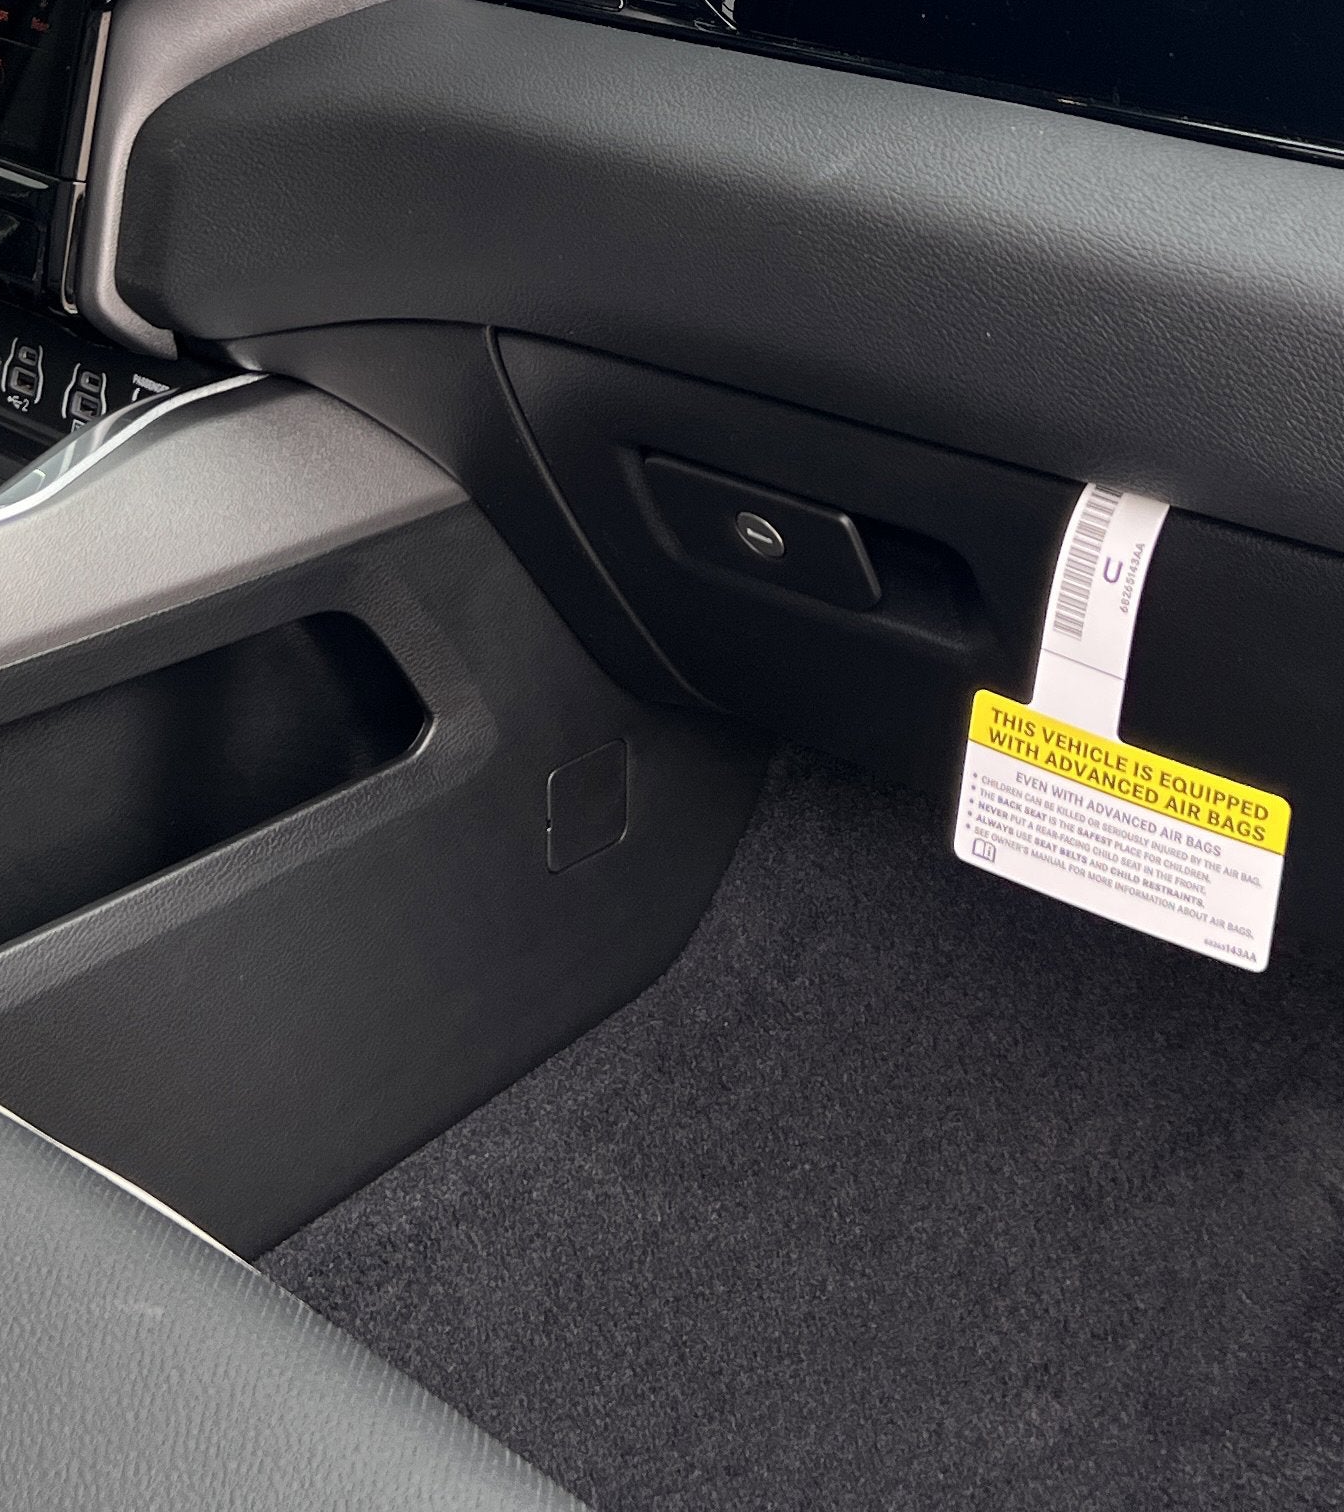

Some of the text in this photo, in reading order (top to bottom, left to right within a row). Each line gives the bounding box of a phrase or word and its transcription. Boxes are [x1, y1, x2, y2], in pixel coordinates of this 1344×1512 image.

[988, 727, 1266, 842] WITH ADVANCED AIR BAGS
[991, 707, 1269, 821] THIS VEHICLE IS EQUIPPED
[976, 814, 1014, 835] ALWAYS
[1016, 829, 1033, 842] USE
[1034, 837, 1056, 853] SEAT
[1059, 849, 1087, 864] BELTS
[1089, 859, 1108, 872] AND
[1110, 866, 1140, 884] CHILD
[978, 801, 1009, 820] NEVER
[1010, 813, 1026, 826] PUT
[1092, 846, 1119, 863] CHILD
[1120, 856, 1142, 872] SEAT
[1144, 865, 1153, 875] IN
[1156, 869, 1173, 882] THE
[980, 788, 995, 801] THE
[997, 796, 1022, 812] BACK
[1025, 806, 1047, 821] SEAT
[1048, 814, 1056, 824] IS
[1058, 818, 1075, 832] THE
[1077, 827, 1112, 846] SAFEST
[1114, 841, 1142, 858] PLACE
[1144, 852, 1161, 865] FOR
[981, 775, 1023, 799] CHILDREN
[1024, 792, 1042, 806] CAN
[1044, 800, 1055, 811] BE
[1057, 805, 1086, 823] KILLED
[1087, 817, 1100, 828] OR
[1102, 824, 1149, 848] SERIOUSLY
[1151, 841, 1188, 861] INJURED
[1190, 855, 1203, 866] BY
[1205, 860, 1222, 873] THE
[1223, 867, 1240, 880] AIR
[1016, 771, 1222, 857] EVEN WITH ADVANCED AIR BAGS
[974, 826, 989, 839] SEE
[1031, 848, 1066, 870] MANUAL
[1068, 863, 1086, 878] FOR
[1087, 870, 1113, 888] MORE
[1115, 882, 1175, 911] INFORMATION
[1177, 905, 1207, 922] ABOUT
[1209, 916, 1226, 929] AIR
